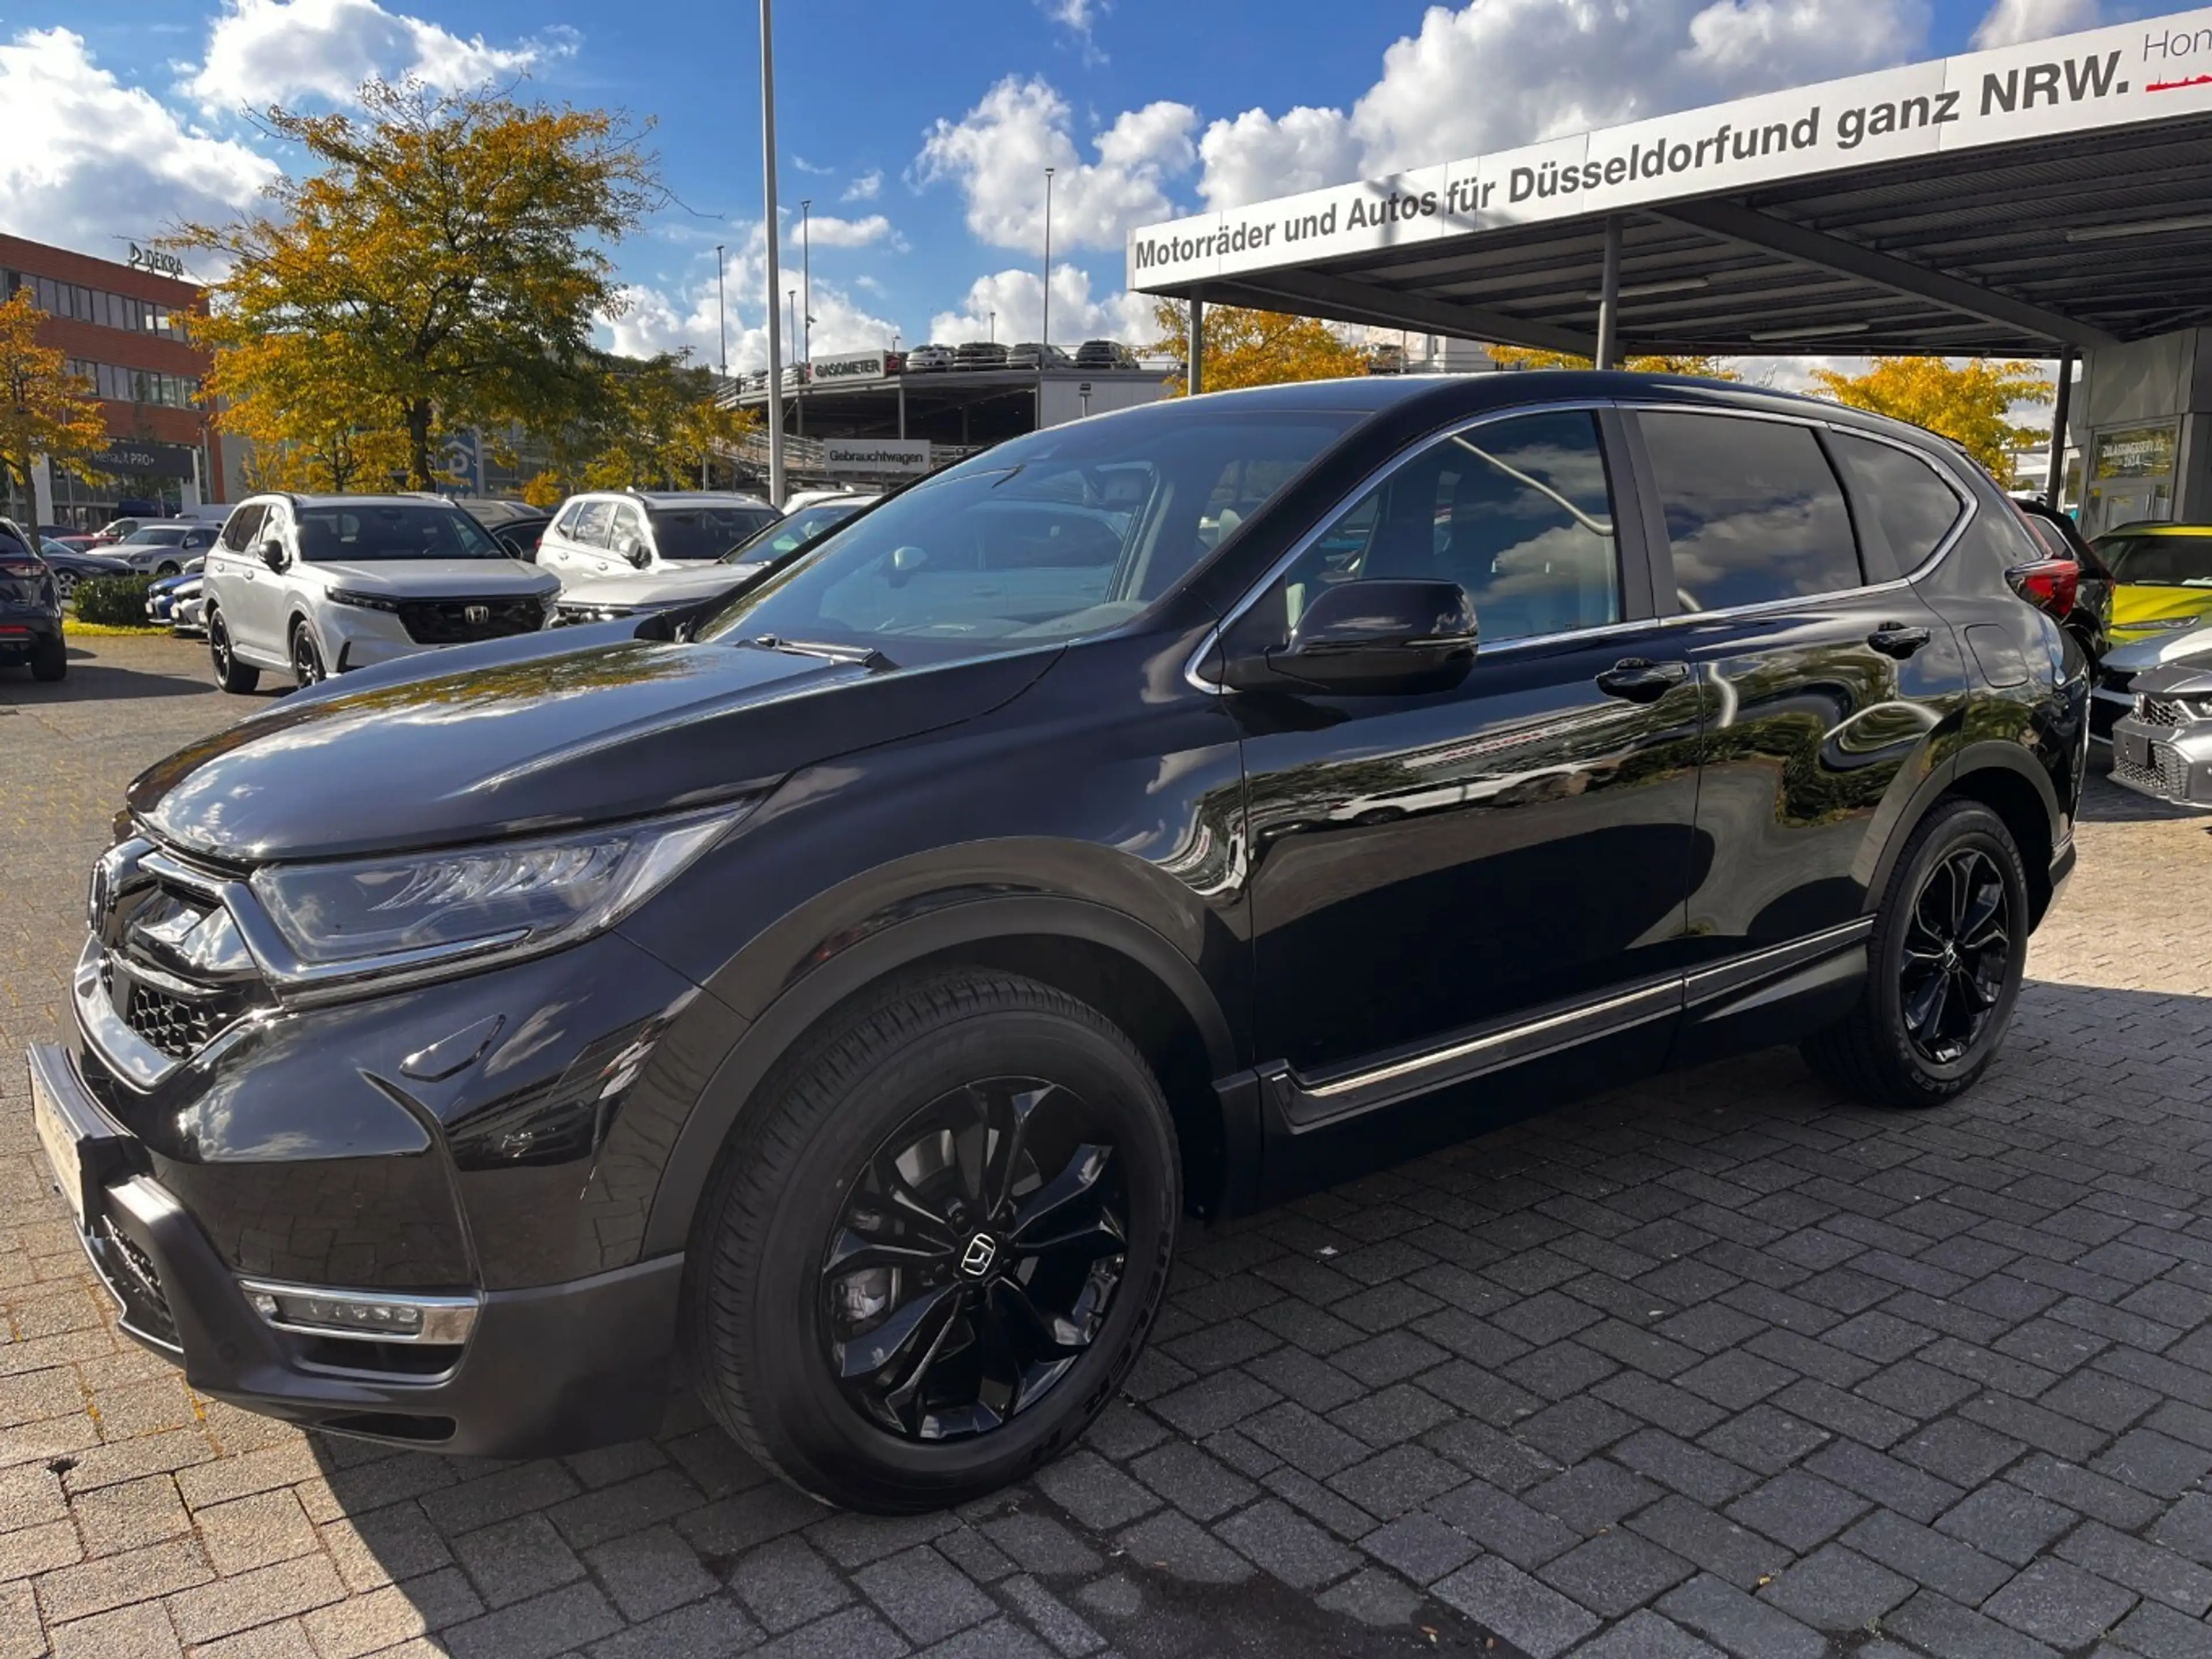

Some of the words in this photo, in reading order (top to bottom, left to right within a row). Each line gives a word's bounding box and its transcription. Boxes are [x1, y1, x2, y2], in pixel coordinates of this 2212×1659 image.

[1135, 221, 1276, 270] Motorräder
[1284, 203, 1336, 243] und
[1347, 191, 1438, 231] Autos
[1446, 176, 1496, 215] für
[1836, 90, 1960, 150] ganz
[1979, 50, 2130, 116] NRW.
[145, 249, 184, 276] DEKRA
[815, 359, 881, 378] GASOMETER
[829, 449, 924, 465] Gebrauchtwagen
